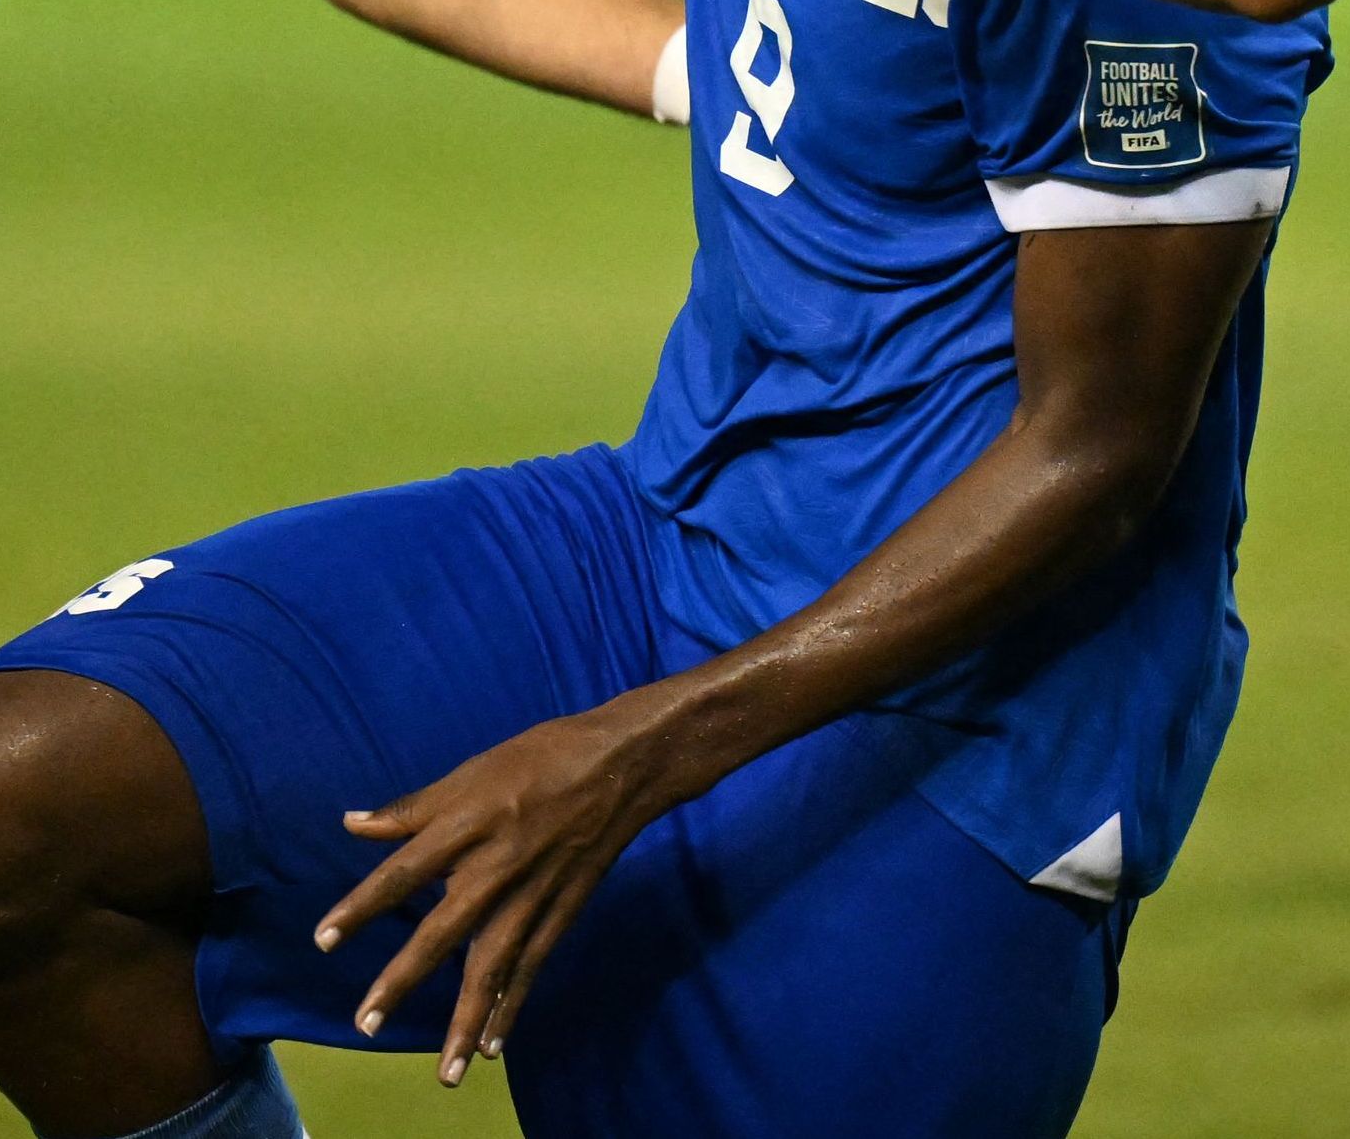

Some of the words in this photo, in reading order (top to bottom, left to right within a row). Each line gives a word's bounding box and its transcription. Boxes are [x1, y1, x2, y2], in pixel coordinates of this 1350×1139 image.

[1101, 61, 1178, 81] FOOTBALL
[1101, 82, 1179, 107] UNITES
[1096, 108, 1129, 128] the
[1132, 103, 1183, 128] World
[1127, 136, 1160, 148] FIFA
